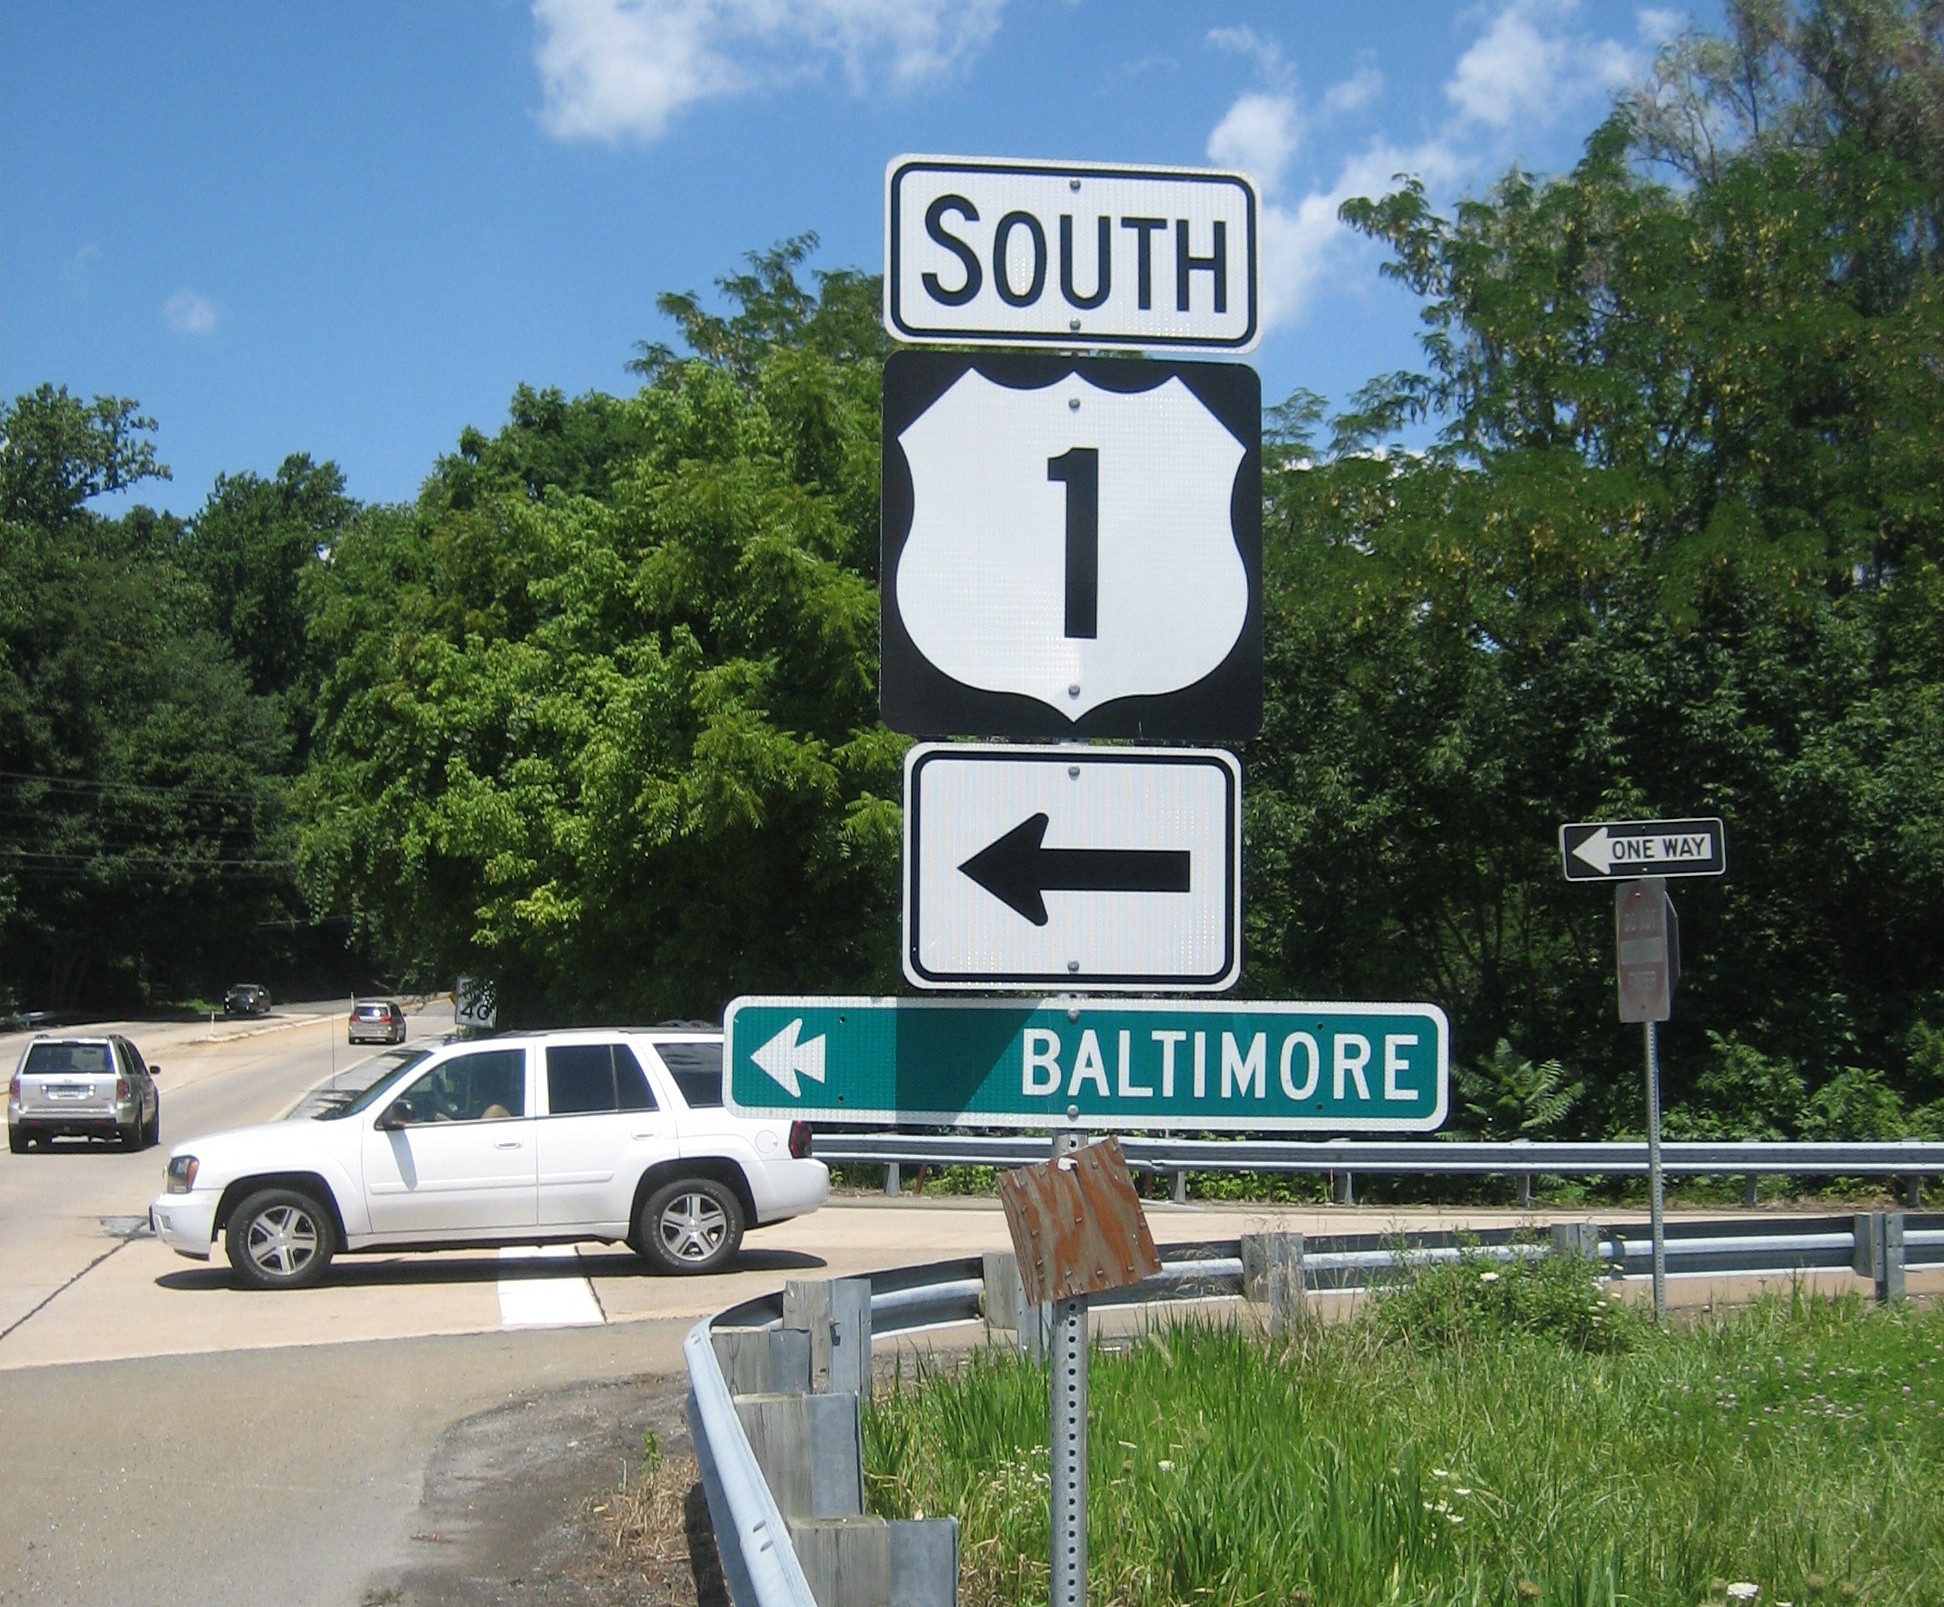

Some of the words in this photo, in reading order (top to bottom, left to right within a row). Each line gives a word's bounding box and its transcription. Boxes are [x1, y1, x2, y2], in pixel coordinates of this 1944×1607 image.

[921, 193, 1227, 314] SOUTH
[1047, 447, 1099, 640] 1
[1612, 839, 1655, 861] ONE
[1662, 836, 1706, 858] WAY
[459, 1002, 493, 1021] 40
[1022, 1028, 1419, 1101] BALTIMORE
